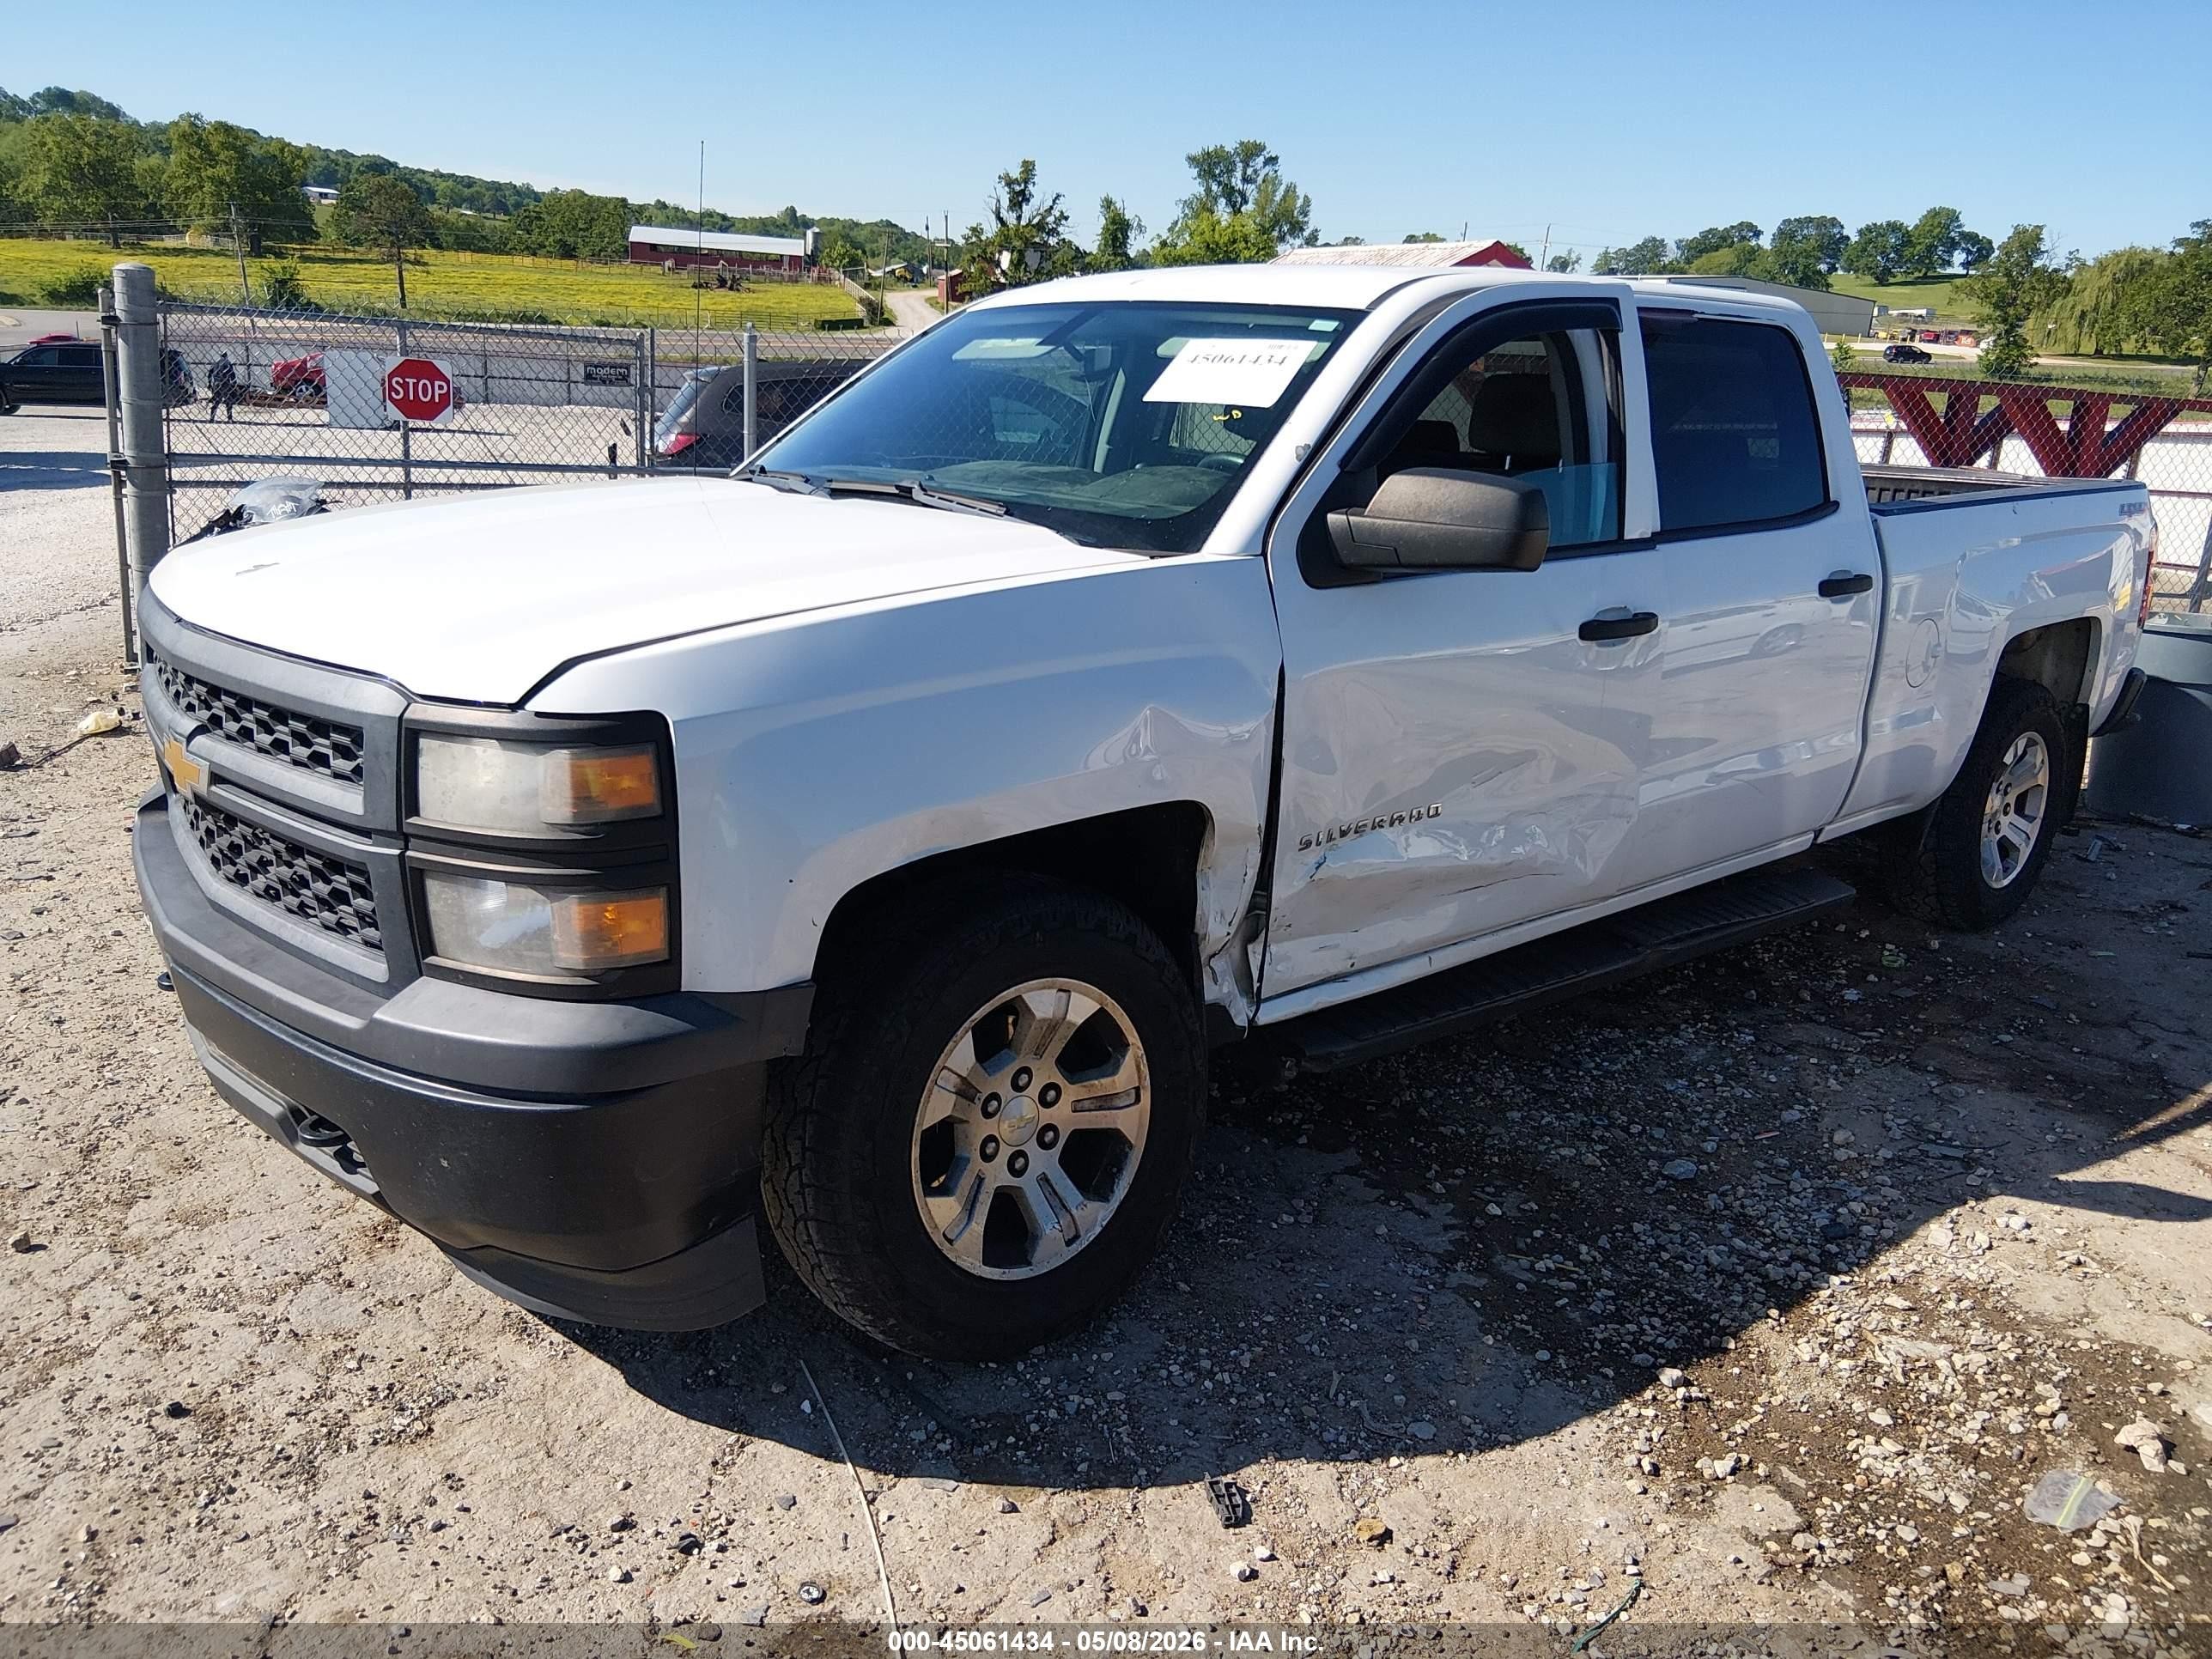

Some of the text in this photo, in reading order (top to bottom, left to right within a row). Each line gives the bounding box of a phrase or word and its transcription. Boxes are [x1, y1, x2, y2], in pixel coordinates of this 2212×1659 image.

[1188, 353, 1289, 367] 45061434
[586, 366, 628, 376] modern
[391, 376, 448, 403] STOP
[1297, 802, 1443, 853] SILVERADO
